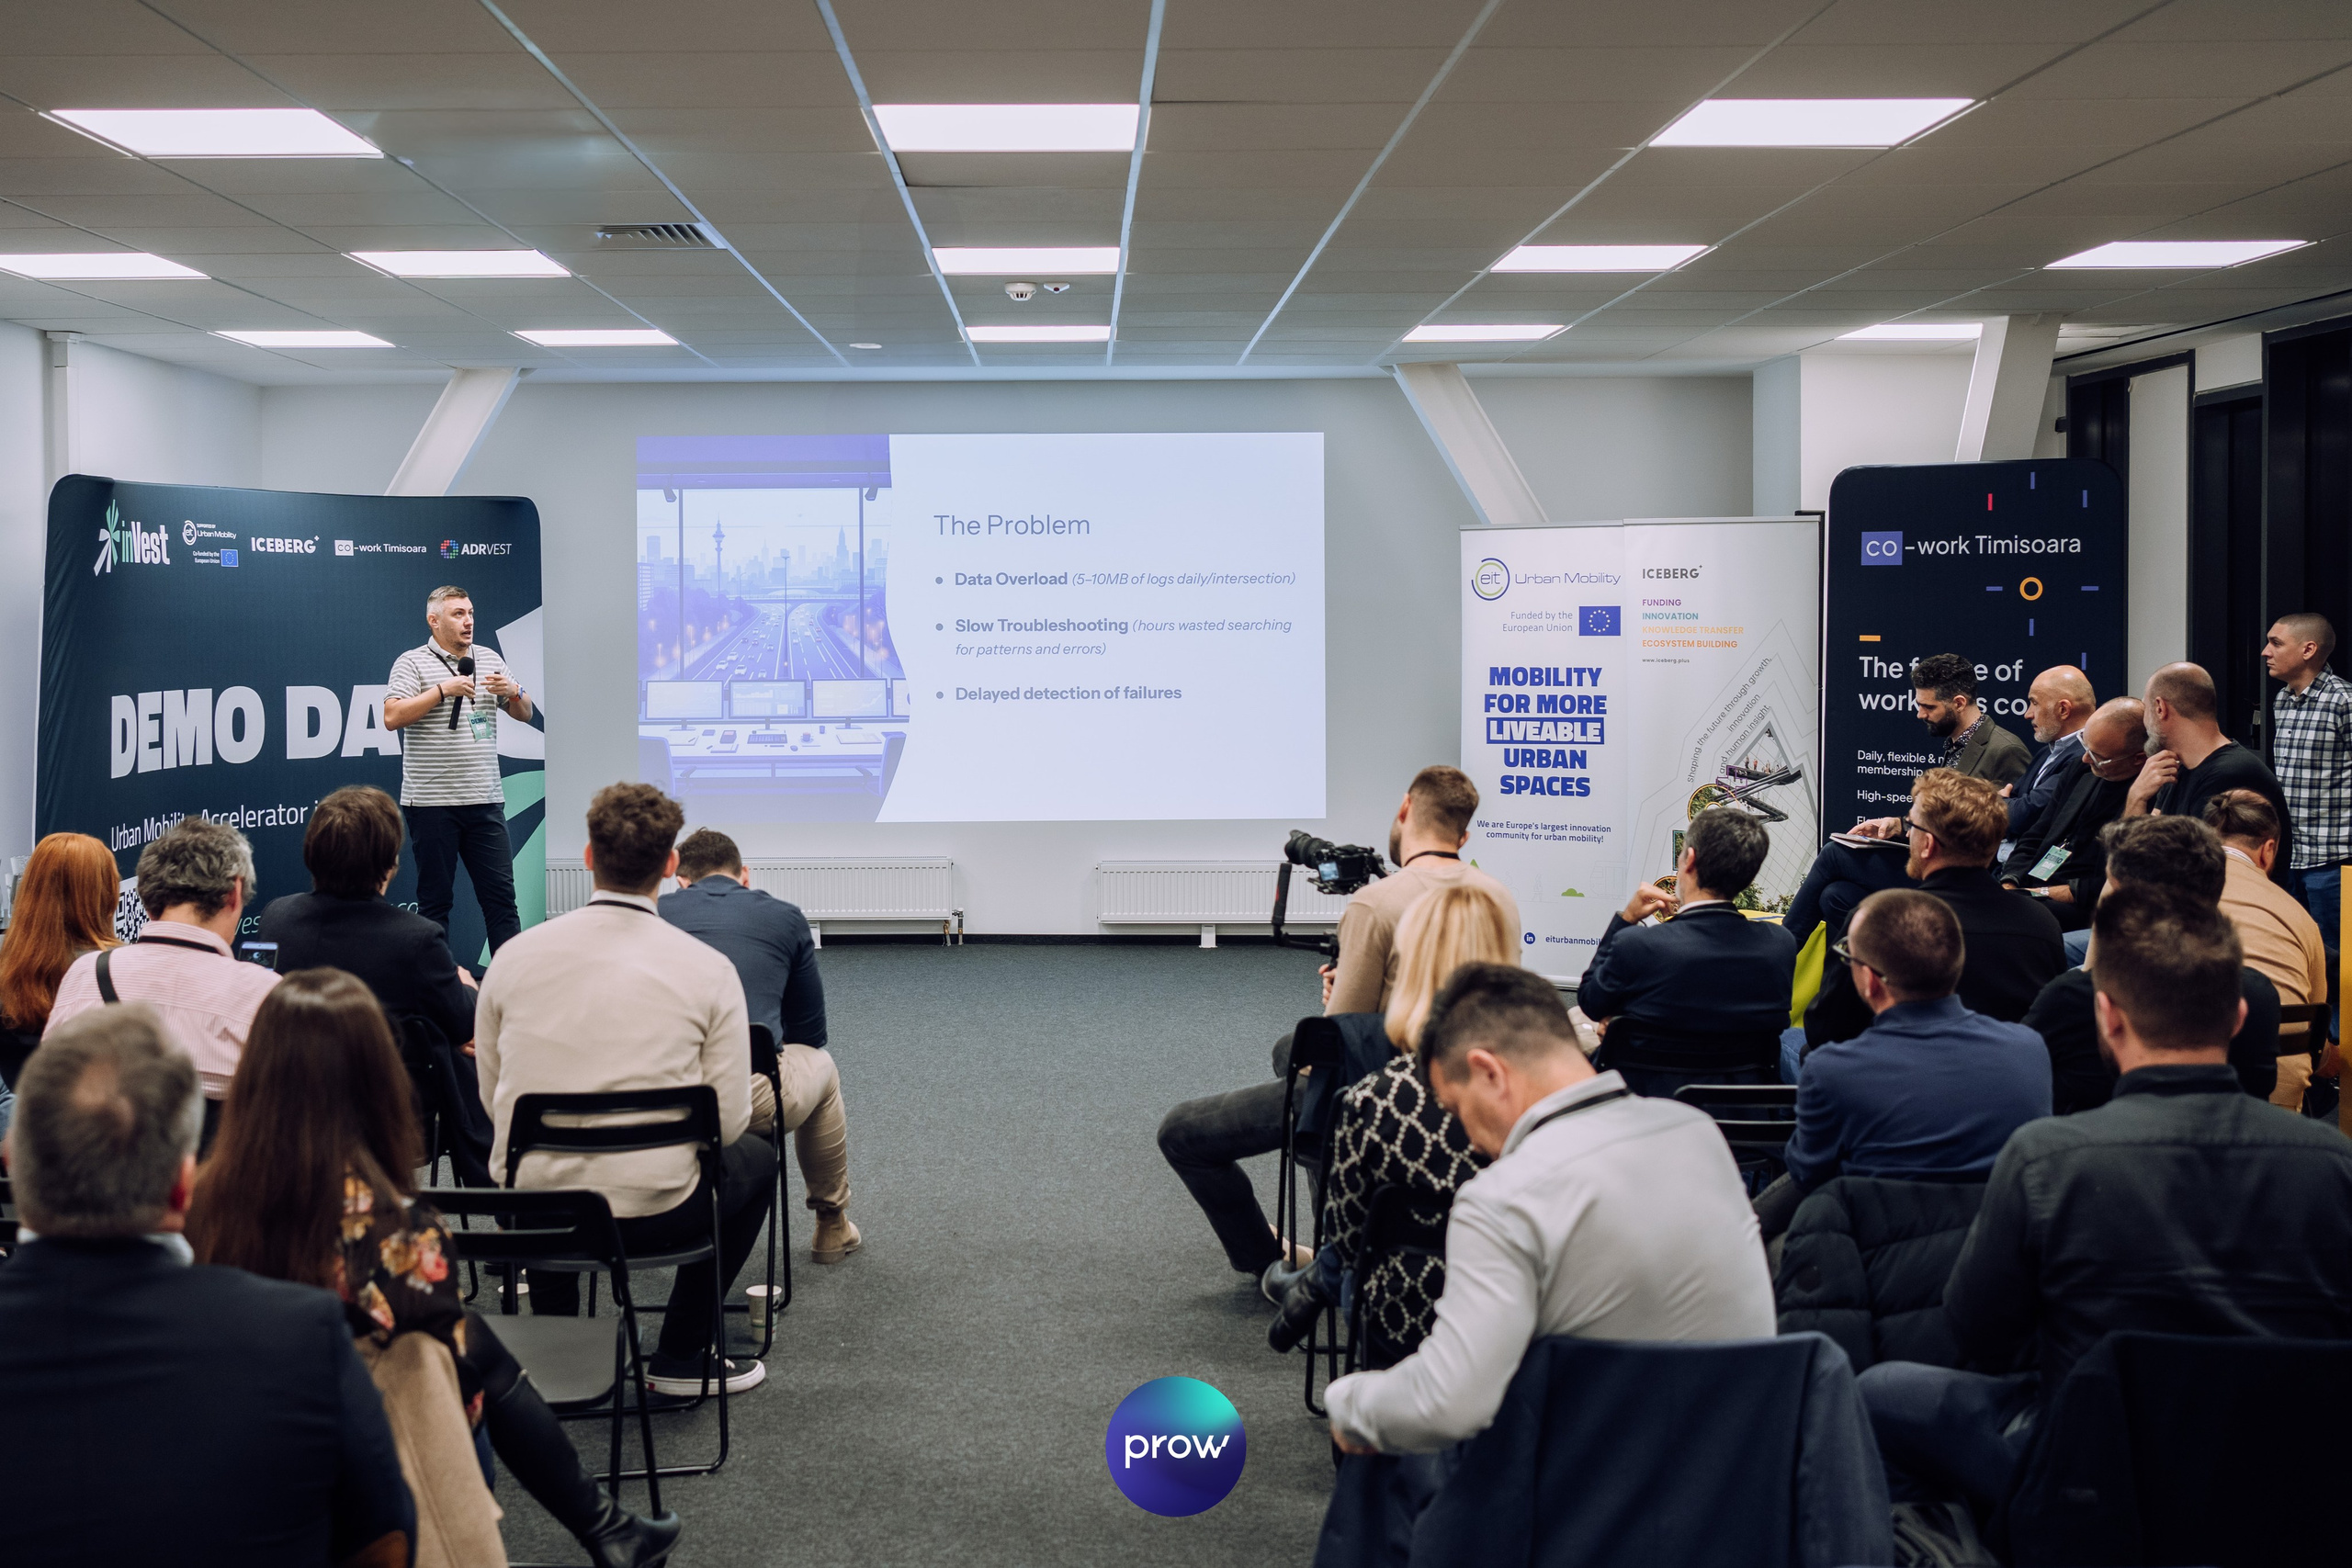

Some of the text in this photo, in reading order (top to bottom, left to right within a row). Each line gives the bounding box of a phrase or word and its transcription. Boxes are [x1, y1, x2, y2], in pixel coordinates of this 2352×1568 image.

[933, 513, 1091, 536] The Problem
[122, 520, 171, 565] inVest
[214, 530, 237, 540] Mobility
[383, 543, 427, 553] Timisoara
[460, 543, 513, 556] ADRVEST
[1974, 535, 2082, 555] Timisoara
[956, 572, 992, 586] Data
[995, 571, 1068, 586] Overload
[1131, 571, 1146, 586] of
[1147, 571, 1175, 588] logs
[1176, 570, 1296, 588] daily/intersection)
[1479, 570, 1622, 586] eit Urban Mobility
[1642, 598, 1682, 607] FUNDING
[1510, 610, 1573, 623] Funded by the
[1642, 612, 1699, 621] INNOVATION
[956, 617, 1292, 635] Slow Troubleshooting (hours wasted searching
[1502, 623, 1573, 635] European Union
[1642, 626, 1744, 635] KNOWLEDGE TRANSFER
[956, 642, 1107, 658] for patterns and errors)
[1642, 639, 1738, 649] ECOSYSTEM BUILDING
[1488, 666, 1602, 687] MOBILITY
[1859, 656, 1904, 679] The
[1995, 659, 2023, 682] of
[956, 685, 1182, 704] Delayed detection of failures
[1484, 694, 1608, 716] FOR MORE
[1727, 694, 1761, 732] innovation
[1687, 657, 1772, 784] Shaping the future through growth,
[111, 684, 402, 779] DEMO DA
[1489, 720, 1602, 743] LIVEABLE
[1719, 705, 1771, 774] and human insight.
[1503, 748, 1588, 770] URBAN
[1857, 750, 1885, 763] Daily,
[1887, 751, 1927, 763] flexible
[1928, 753, 1936, 763] &
[1857, 765, 1924, 779] membership
[1499, 774, 1591, 797] SPACES
[1857, 789, 1914, 804] High-spee
[1476, 819, 1611, 834] We are Europe's largest innovation
[111, 822, 141, 852] Urban
[1486, 831, 1605, 844] community for urban mobility!
[1545, 935, 1601, 946] eiturbanmobil
